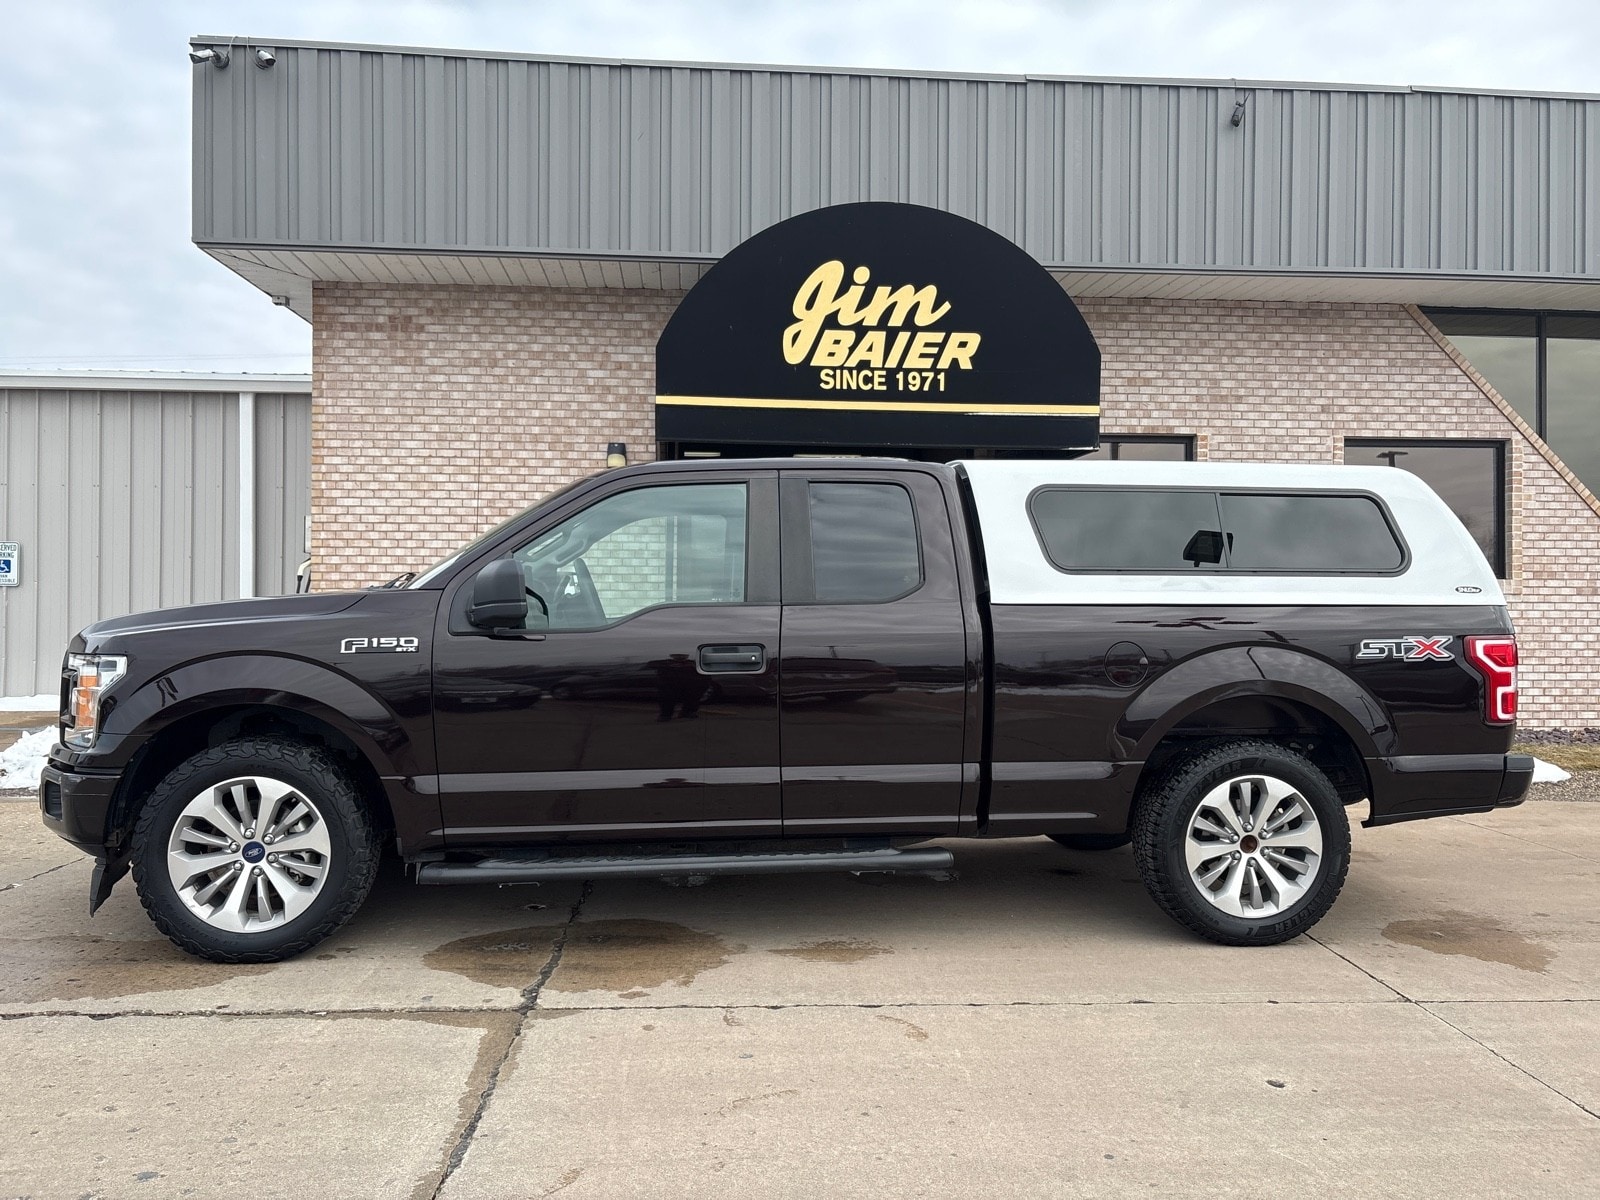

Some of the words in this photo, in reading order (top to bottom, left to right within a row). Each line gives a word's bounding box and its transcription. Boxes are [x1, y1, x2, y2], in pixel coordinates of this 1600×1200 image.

[783, 260, 952, 365] Jim
[809, 329, 982, 370] BAIER
[819, 369, 887, 391] SINCE
[895, 371, 946, 392] 1971
[1356, 635, 1456, 662] STX
